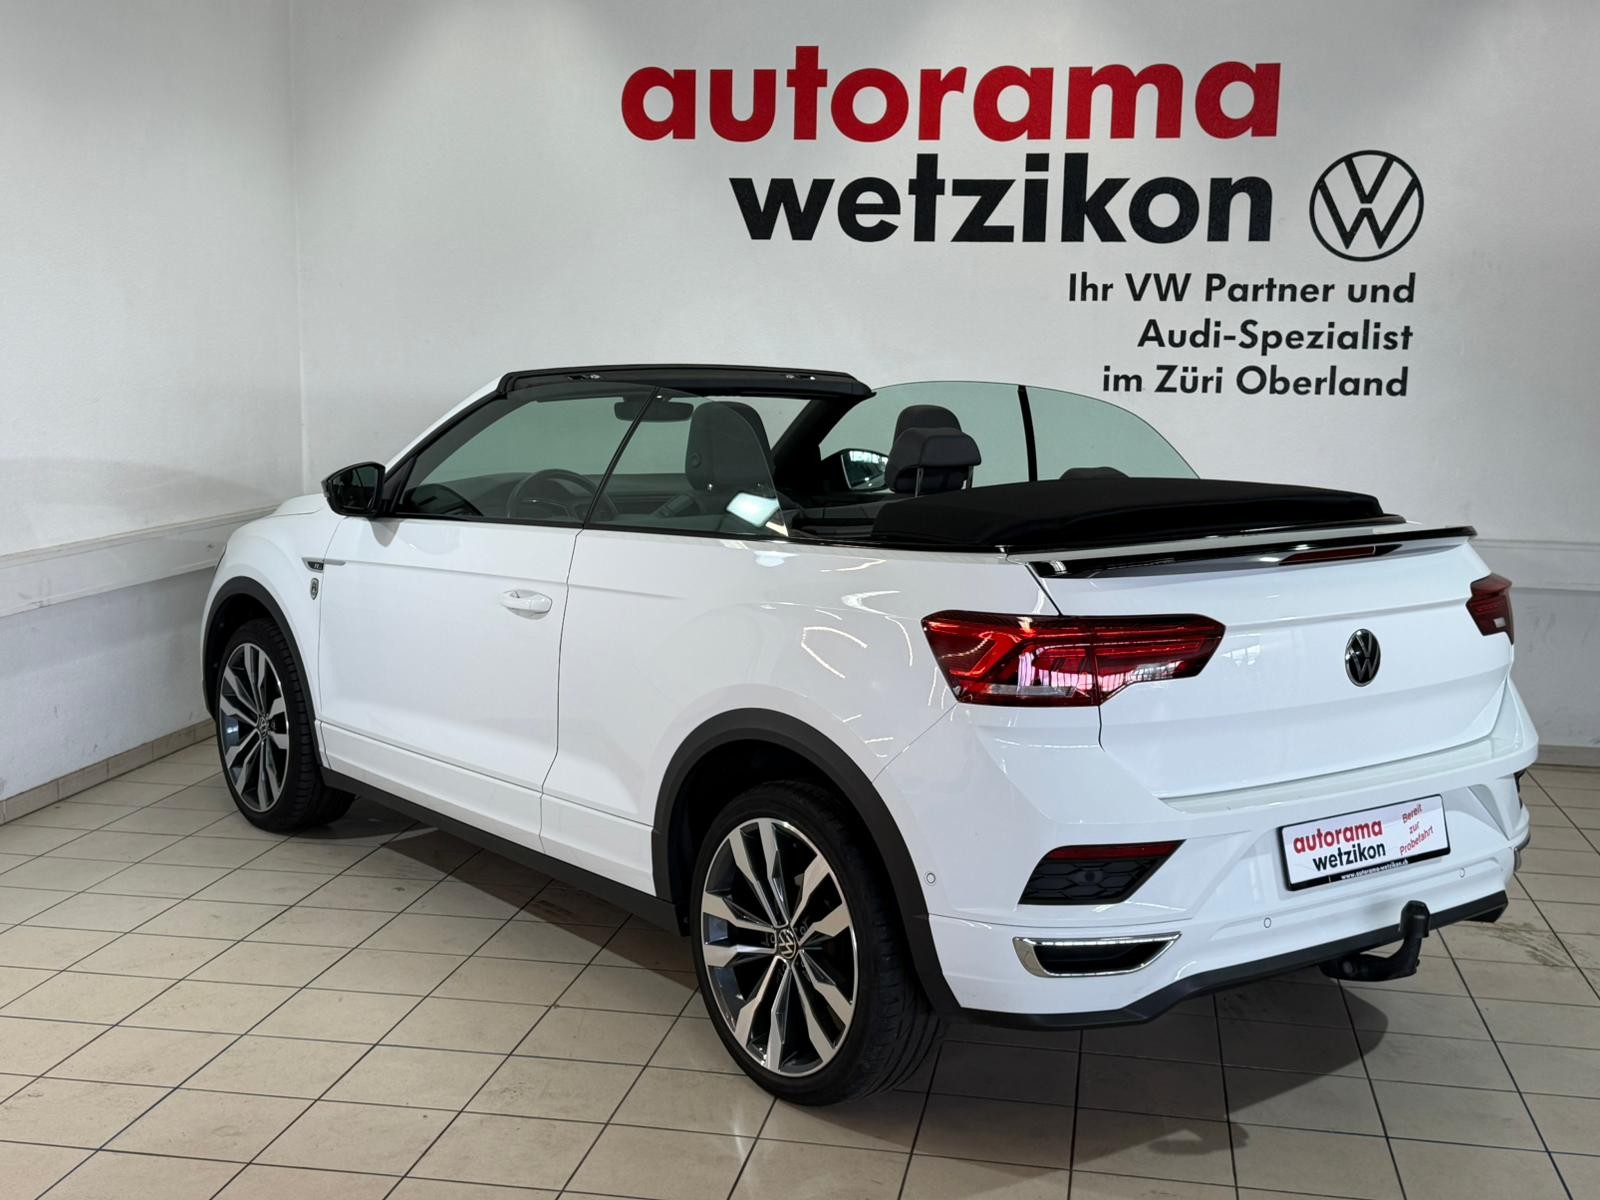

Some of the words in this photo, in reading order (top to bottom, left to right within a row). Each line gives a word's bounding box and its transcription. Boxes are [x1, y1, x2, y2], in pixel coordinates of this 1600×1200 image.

[622, 46, 1281, 144] autorama
[728, 152, 1273, 245] wetzikon
[1068, 271, 1114, 302] Ihr
[1124, 272, 1192, 302] VW
[1204, 272, 1336, 303] Partner
[1347, 271, 1417, 304] und
[1136, 317, 1414, 357] Audi-Spezialist
[1102, 365, 1143, 393] im
[1154, 364, 1224, 394] Züri
[1235, 364, 1409, 397] Oberland
[1402, 803, 1422, 824] Bereit
[1409, 821, 1420, 835] zur
[1293, 820, 1383, 854] autorama
[1400, 825, 1434, 856] Probefahrt
[1312, 842, 1387, 872] wetzikon
